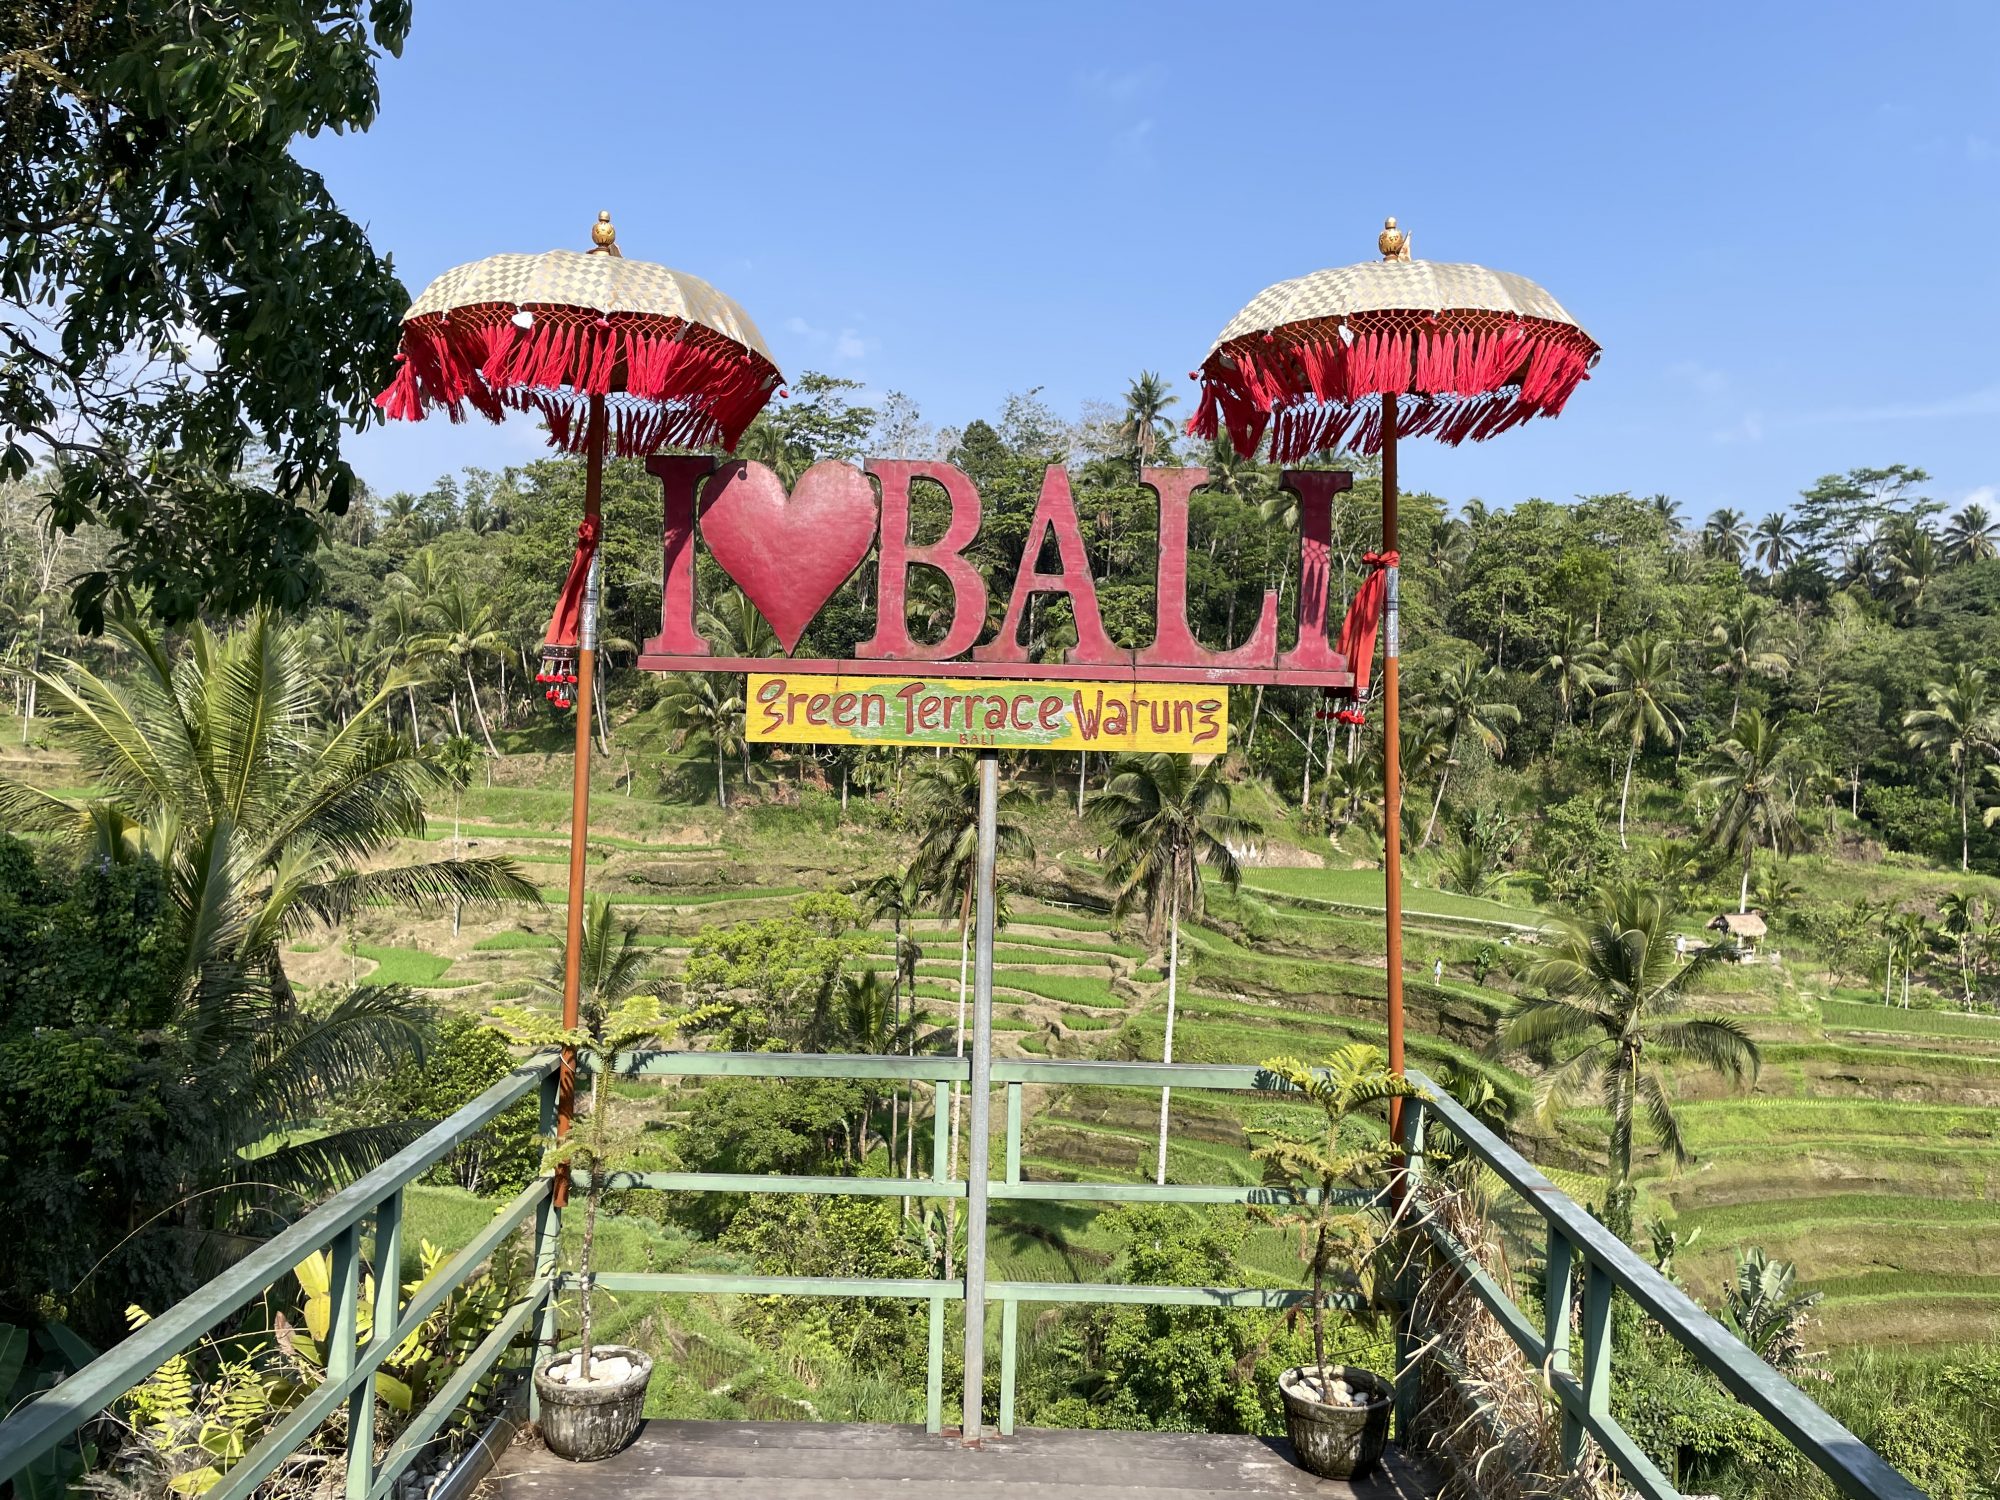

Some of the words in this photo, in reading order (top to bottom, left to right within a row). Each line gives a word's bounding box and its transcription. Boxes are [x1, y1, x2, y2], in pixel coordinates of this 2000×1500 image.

[642, 455, 717, 657] I
[854, 457, 1353, 672] BALI
[896, 681, 1064, 735] Terrace
[1072, 689, 1222, 744] Warung
[959, 733, 995, 745] BALI
